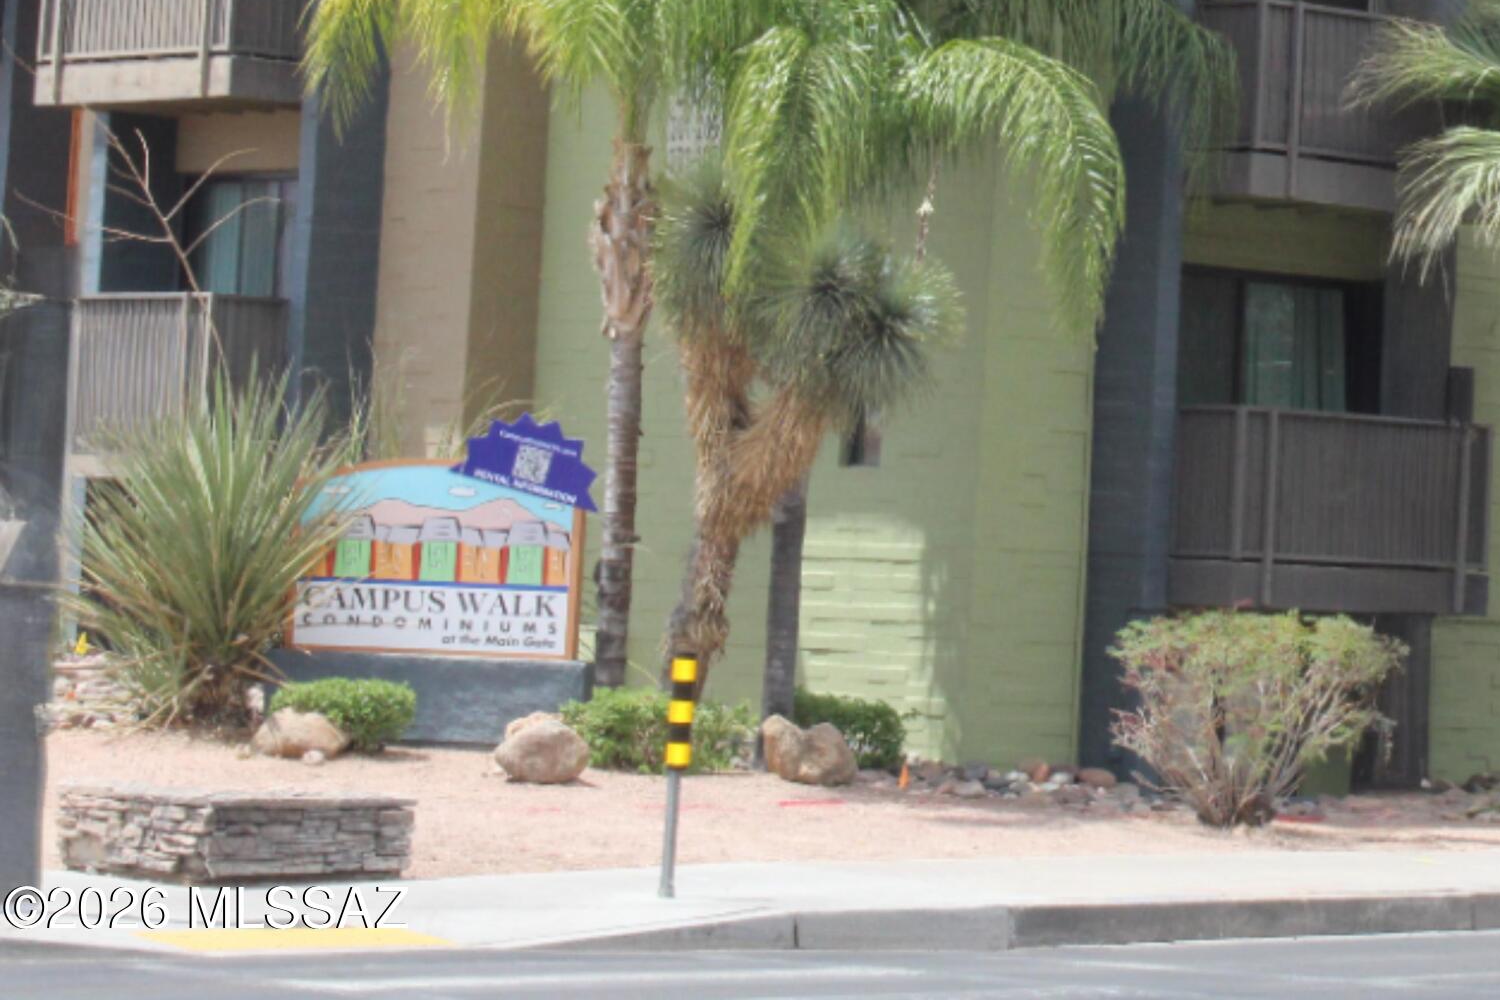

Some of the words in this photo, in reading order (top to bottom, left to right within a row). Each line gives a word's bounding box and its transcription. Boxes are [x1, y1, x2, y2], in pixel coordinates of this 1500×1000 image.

[474, 468, 510, 487] RENTAL
[513, 478, 577, 504] INFORMATION
[303, 585, 446, 614] CAMPUS
[457, 591, 557, 618] WALK
[302, 612, 557, 635] CONDOMINIUMS
[441, 635, 456, 645] at
[459, 634, 481, 646] the
[484, 635, 520, 647] Main
[523, 636, 556, 649] Gate
